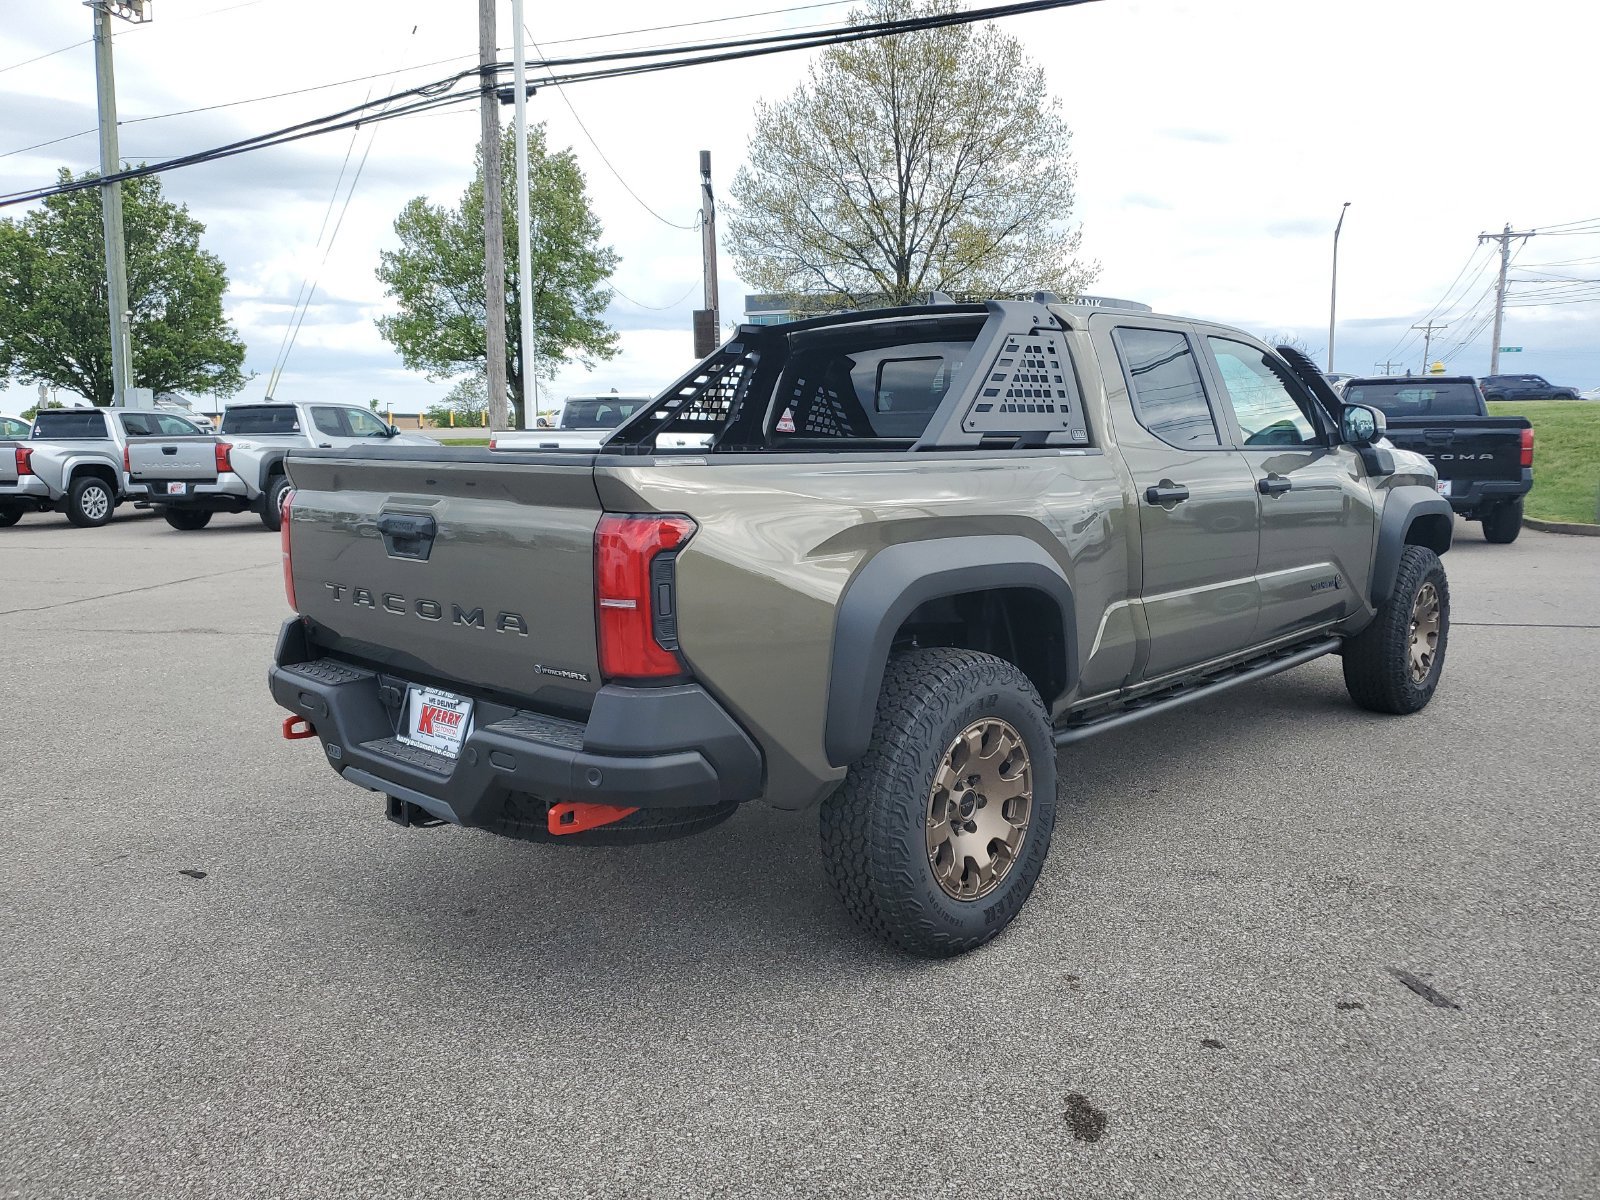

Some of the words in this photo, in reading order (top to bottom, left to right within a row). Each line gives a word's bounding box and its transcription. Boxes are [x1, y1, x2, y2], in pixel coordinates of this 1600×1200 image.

[1424, 453, 1494, 461] COMA
[325, 581, 529, 638] TACOMA
[428, 696, 436, 704] WE
[418, 703, 463, 737] KERRY
